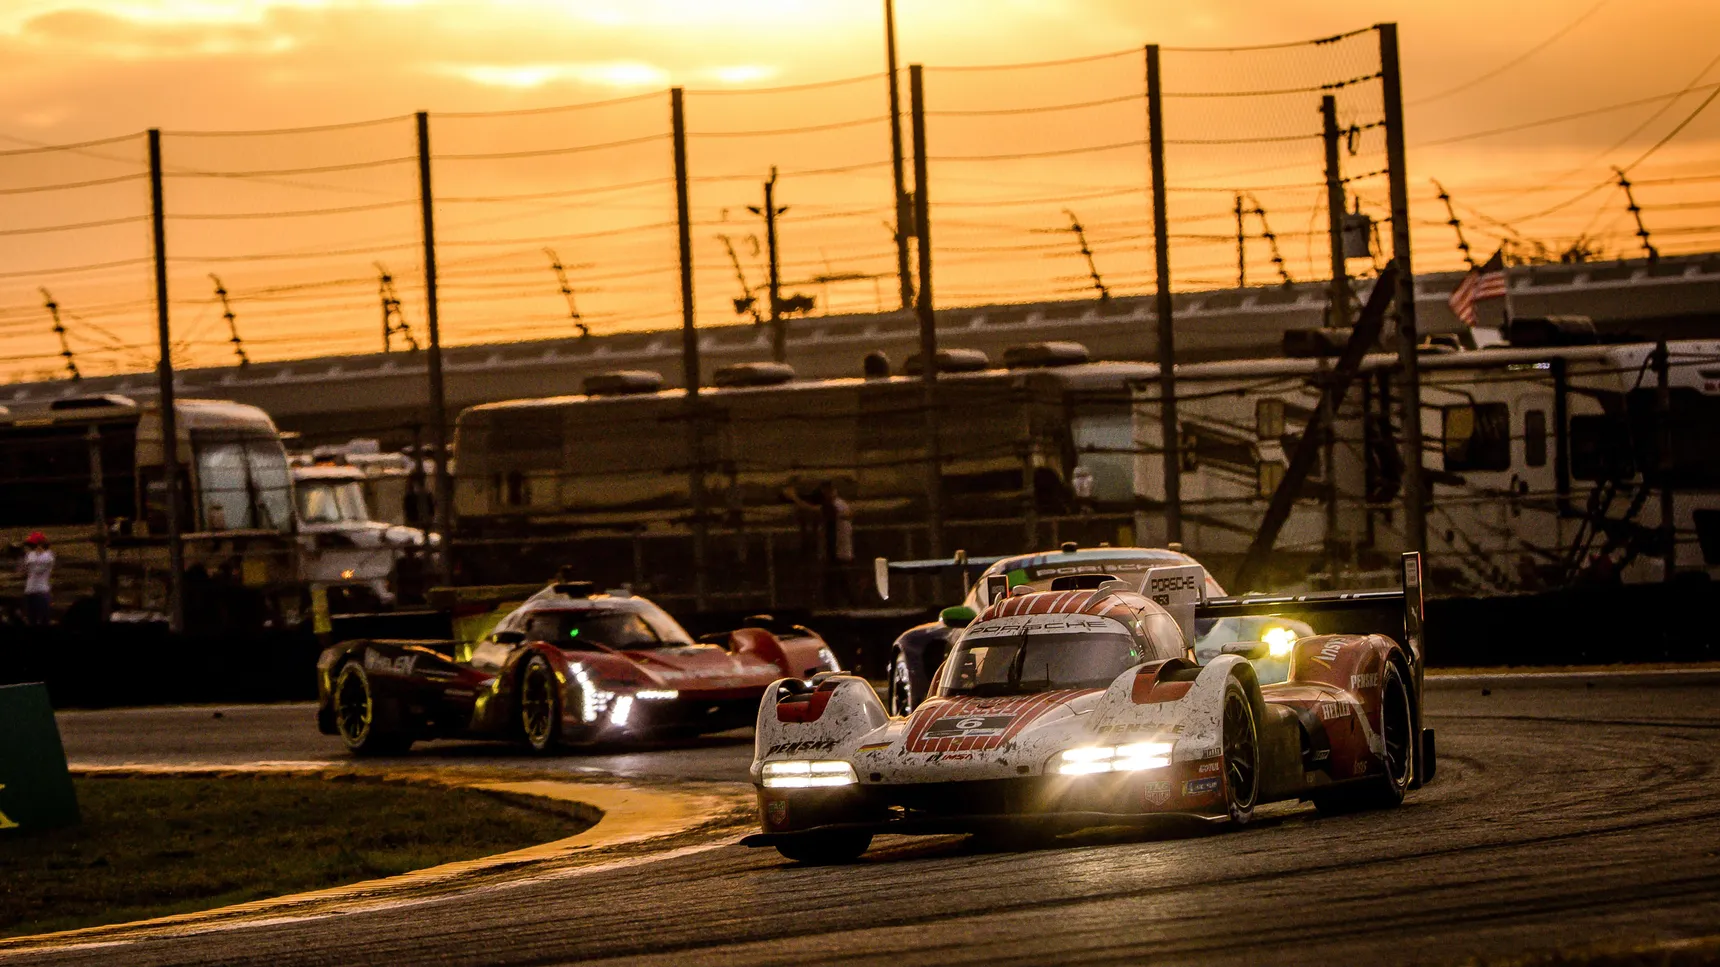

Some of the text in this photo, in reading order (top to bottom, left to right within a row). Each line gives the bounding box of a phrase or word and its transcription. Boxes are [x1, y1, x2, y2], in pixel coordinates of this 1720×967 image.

[1036, 564, 1161, 577] PORSCH
[1151, 576, 1195, 592] PORSCHE
[969, 621, 1107, 636] PORSCHE
[1351, 672, 1378, 689] PENSKE
[1322, 702, 1351, 719] HELLER
[956, 717, 985, 729] 6
[1098, 723, 1185, 735] PENSKE
[766, 740, 841, 757] PENSKE
